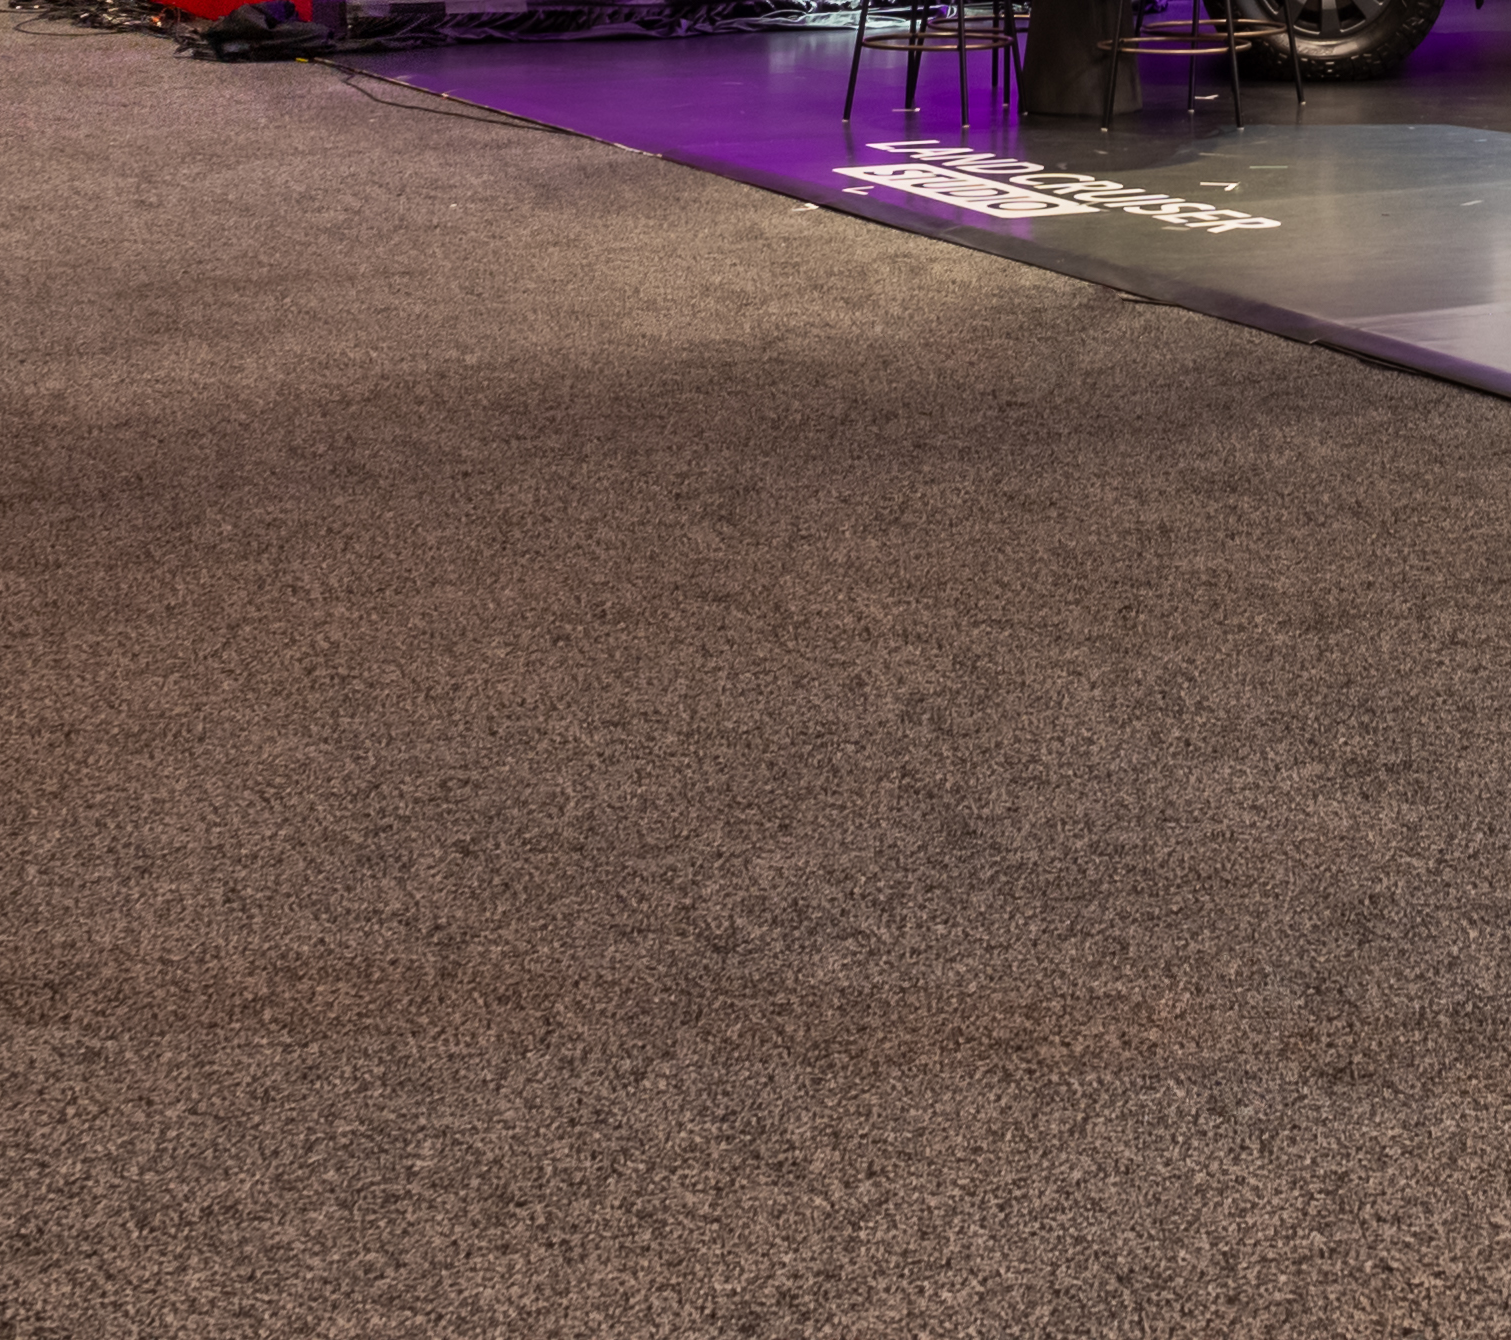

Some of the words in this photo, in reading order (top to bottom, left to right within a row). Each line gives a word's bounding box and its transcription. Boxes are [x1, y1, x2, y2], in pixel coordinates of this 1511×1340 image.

[865, 167, 1050, 212] STUDIO
[866, 140, 1044, 175] LAND
[1009, 173, 1281, 234] CRUISER
